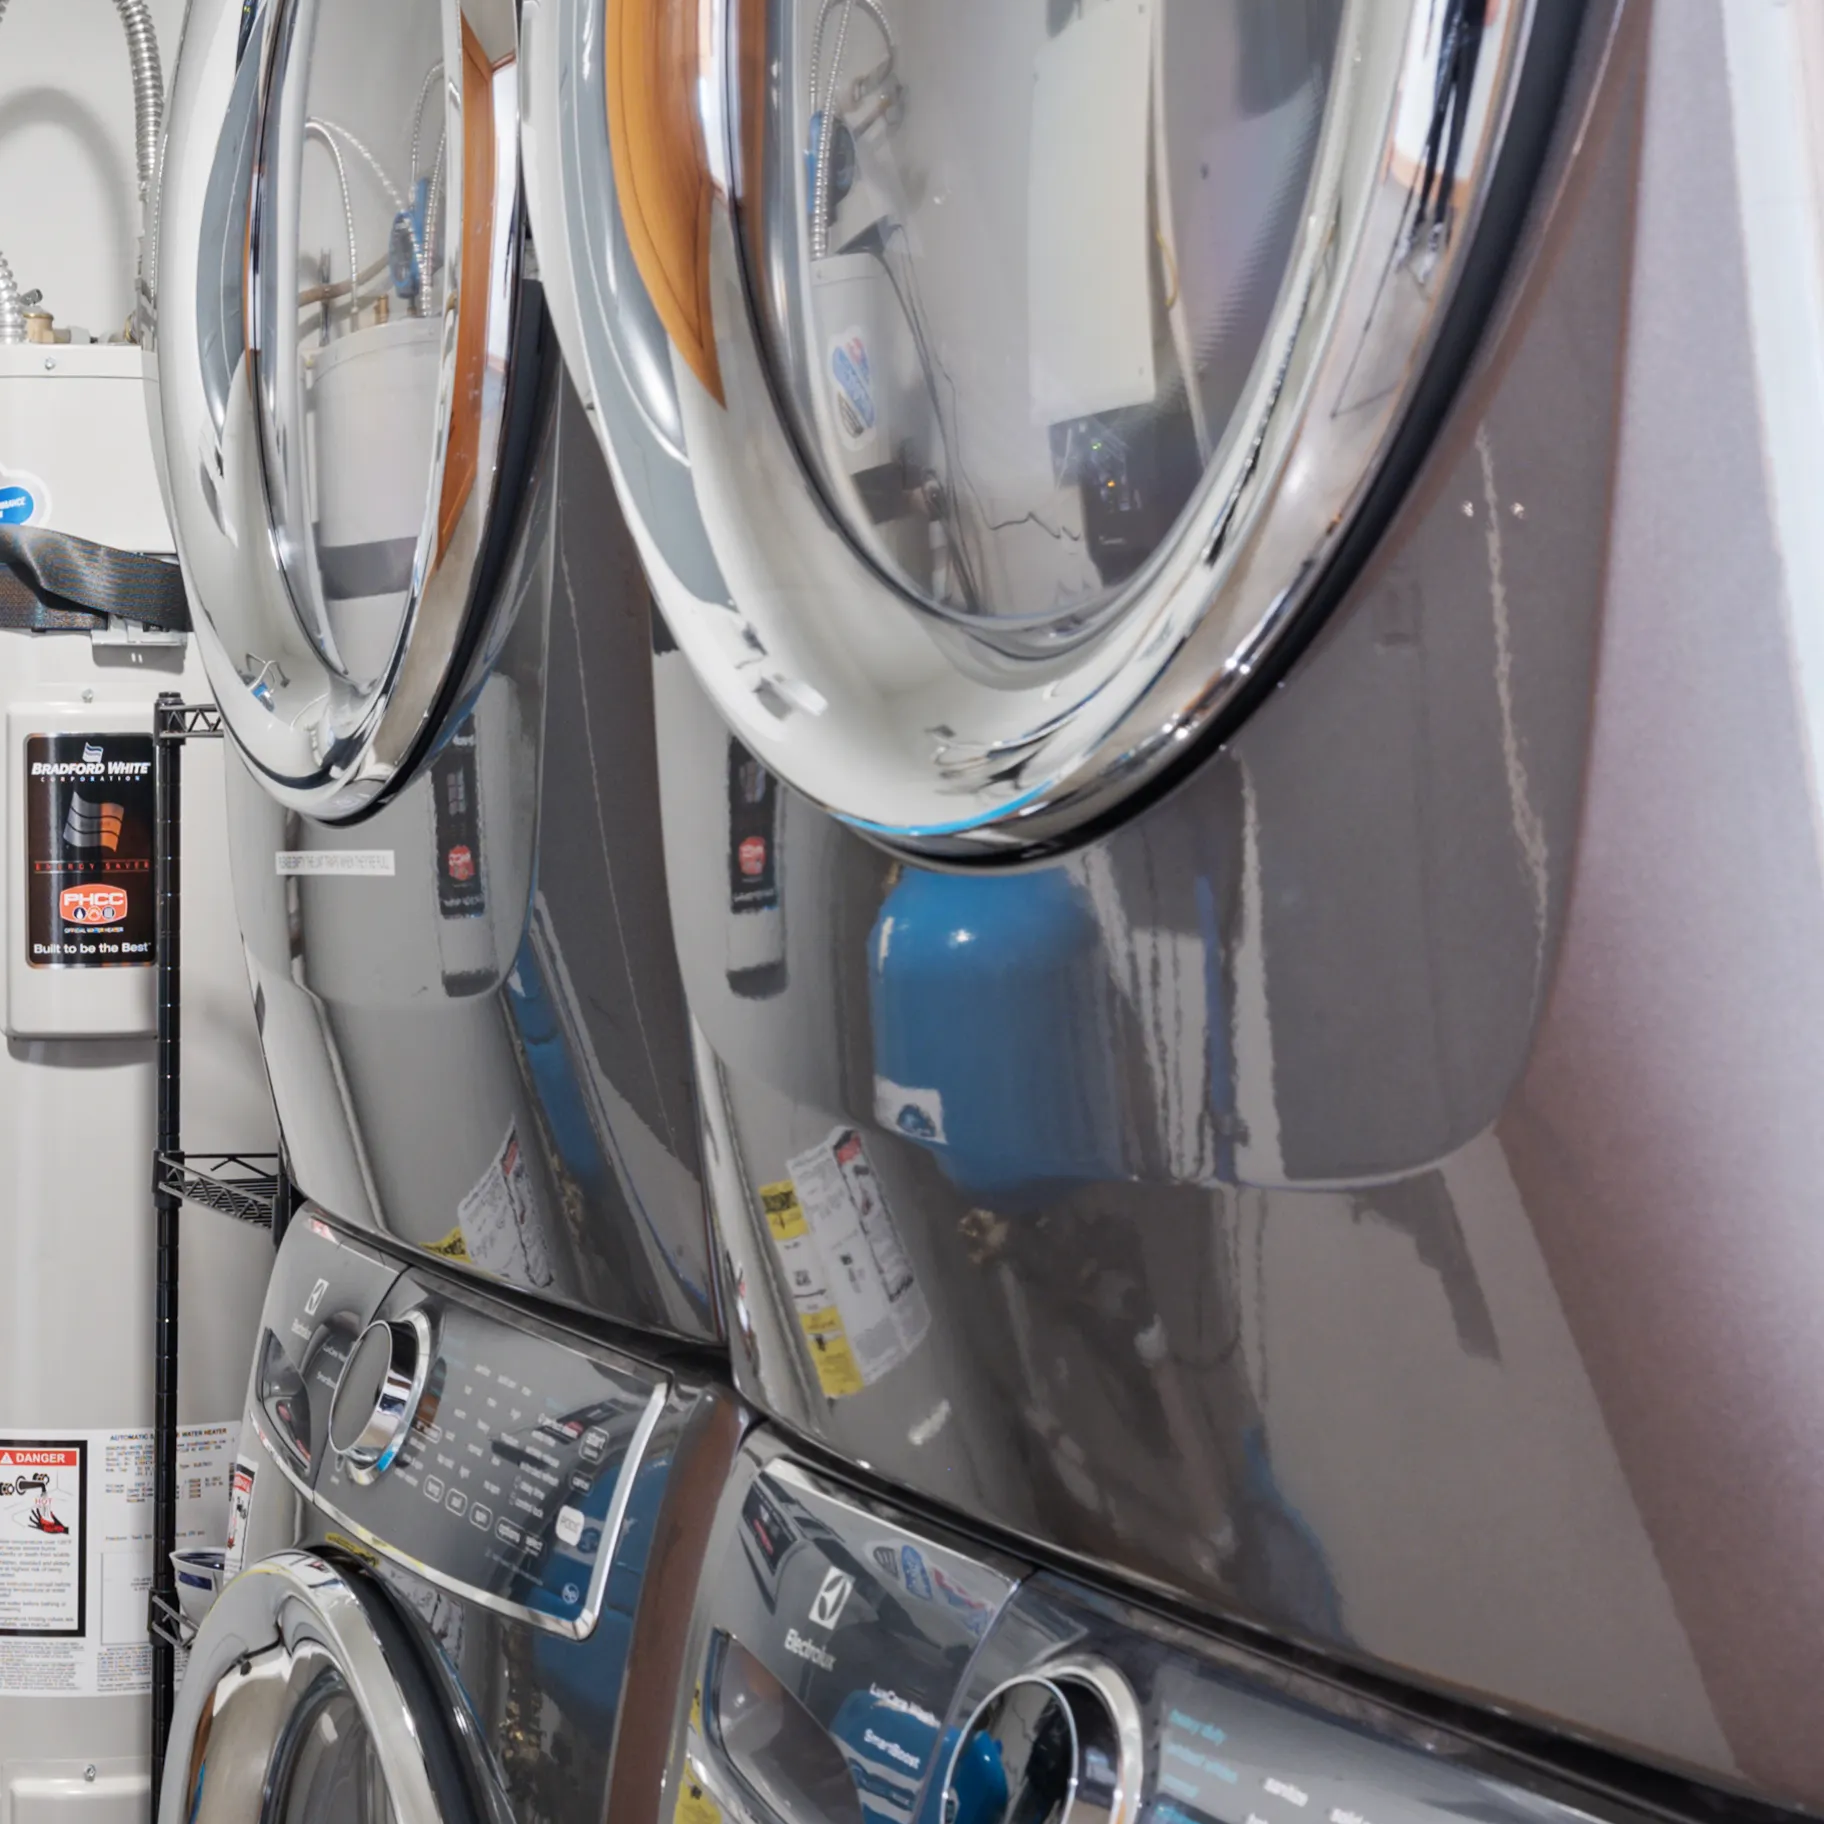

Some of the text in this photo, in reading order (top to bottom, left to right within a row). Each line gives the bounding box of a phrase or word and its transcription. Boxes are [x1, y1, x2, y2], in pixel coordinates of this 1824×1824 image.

[31, 761, 149, 775] BRADFORD WHITE
[40, 775, 140, 783] CORPORATION
[63, 892, 124, 906] PHCC
[33, 942, 149, 954] Built to be the Best
[16, 1453, 65, 1464] DANGER
[34, 1497, 52, 1506] HOT
[784, 1628, 837, 1671] Electrolux
